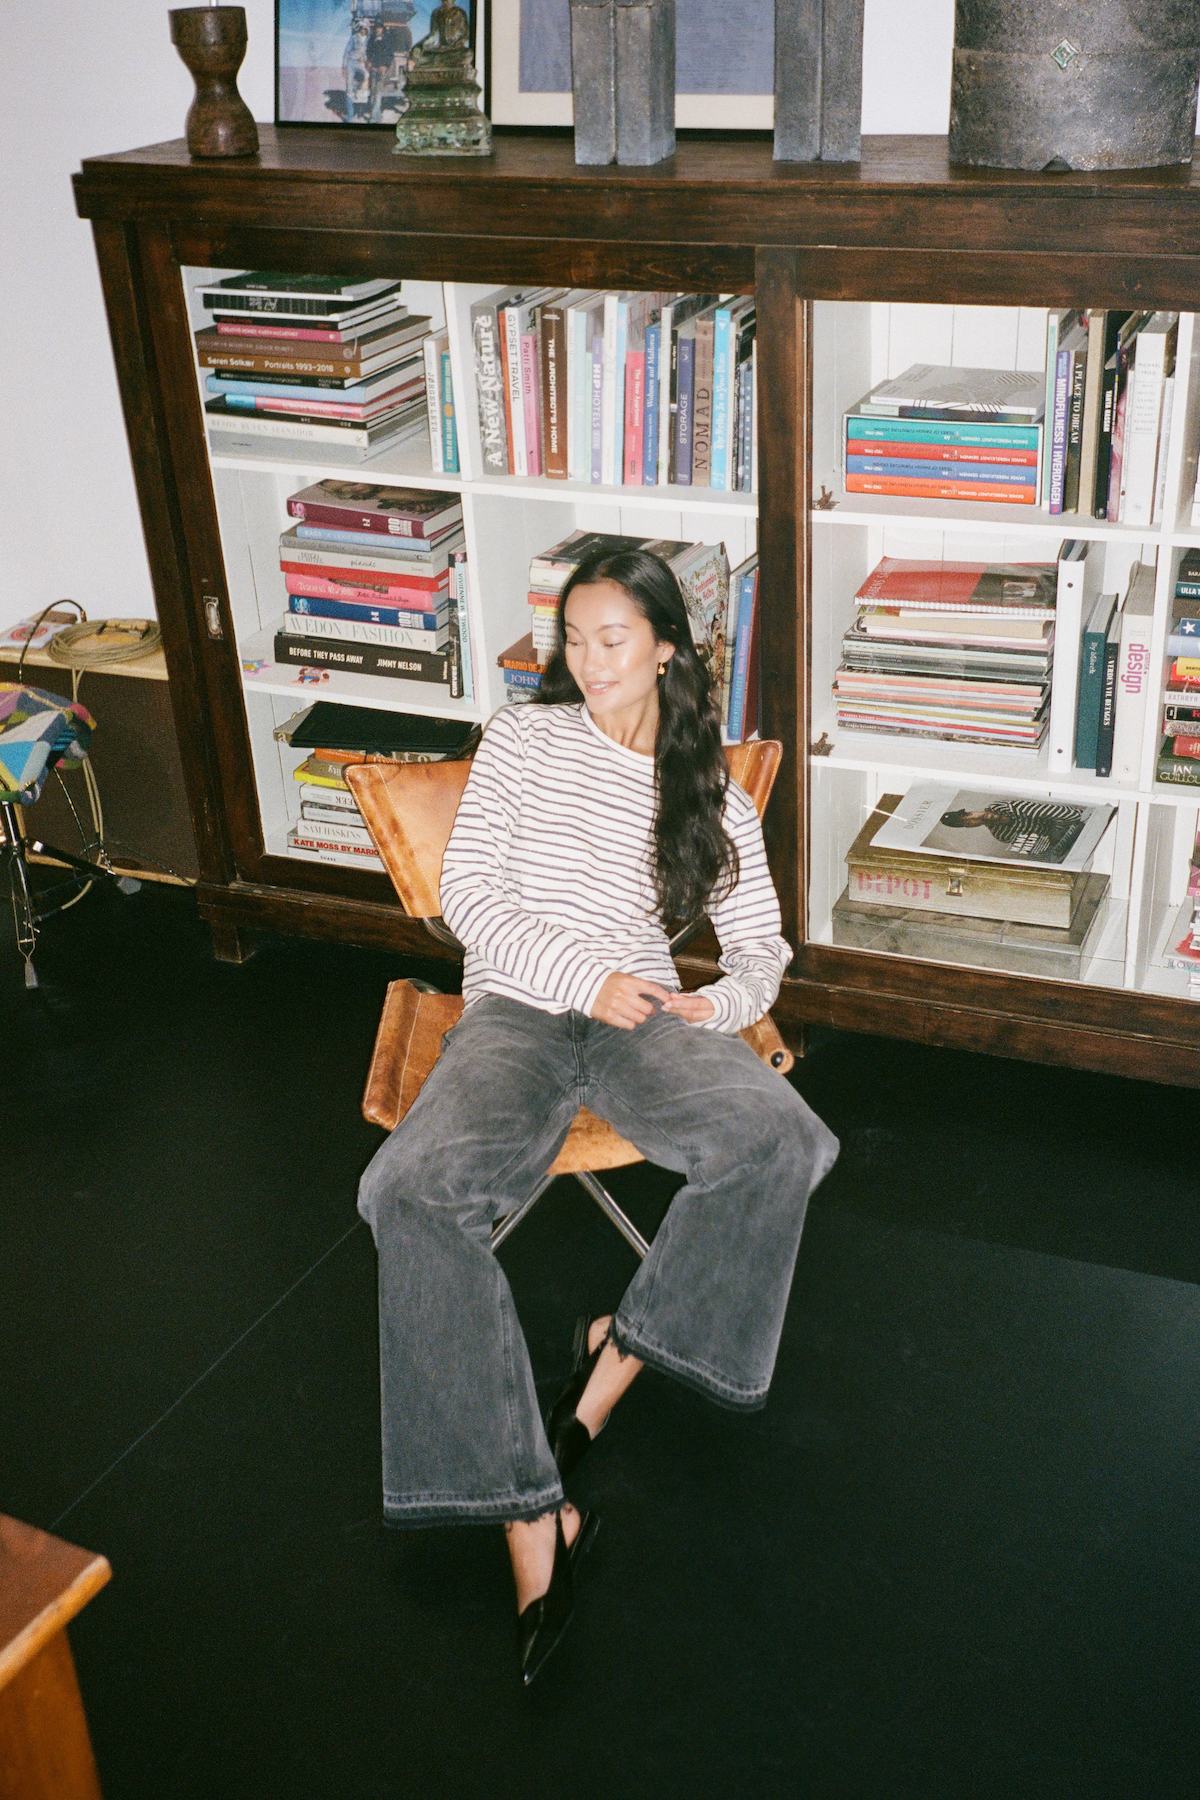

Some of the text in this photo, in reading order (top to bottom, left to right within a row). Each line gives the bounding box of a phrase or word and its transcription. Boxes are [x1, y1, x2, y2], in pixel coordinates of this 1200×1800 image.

[507, 314, 521, 402] GYPSET TRAVEL
[647, 334, 656, 362] Mallorca
[264, 360, 294, 370] Portraits
[522, 341, 532, 395] Patti Smith
[592, 364, 602, 389] HIP
[647, 363, 656, 376] auf
[477, 314, 503, 467] A New Nature
[548, 360, 557, 422] ARCHITECT'S
[1070, 363, 1084, 445] A PLACE TO DREAM
[431, 409, 440, 434] LETH
[591, 390, 602, 428] HOTELS
[678, 392, 689, 445] STORAGE
[1053, 378, 1066, 443] MINDFULNESS
[550, 423, 559, 454] HOME
[694, 387, 711, 471] NOMAD
[1050, 450, 1064, 505] HVERDAGEN
[458, 573, 467, 603] VIVIENNE
[1181, 587, 1197, 595] ULLA
[290, 616, 414, 645] AVEDON FASHION
[289, 646, 364, 665] BEFORE THEY PASS AWAY
[1089, 641, 1099, 654] By
[376, 657, 423, 672] JIMMY NELSON
[509, 673, 538, 686] JOHN
[1106, 660, 1116, 688] VERDEN
[1121, 643, 1150, 695] design
[451, 665, 459, 696] CURVES
[293, 838, 380, 856] KATE MOSS BY MARIO
